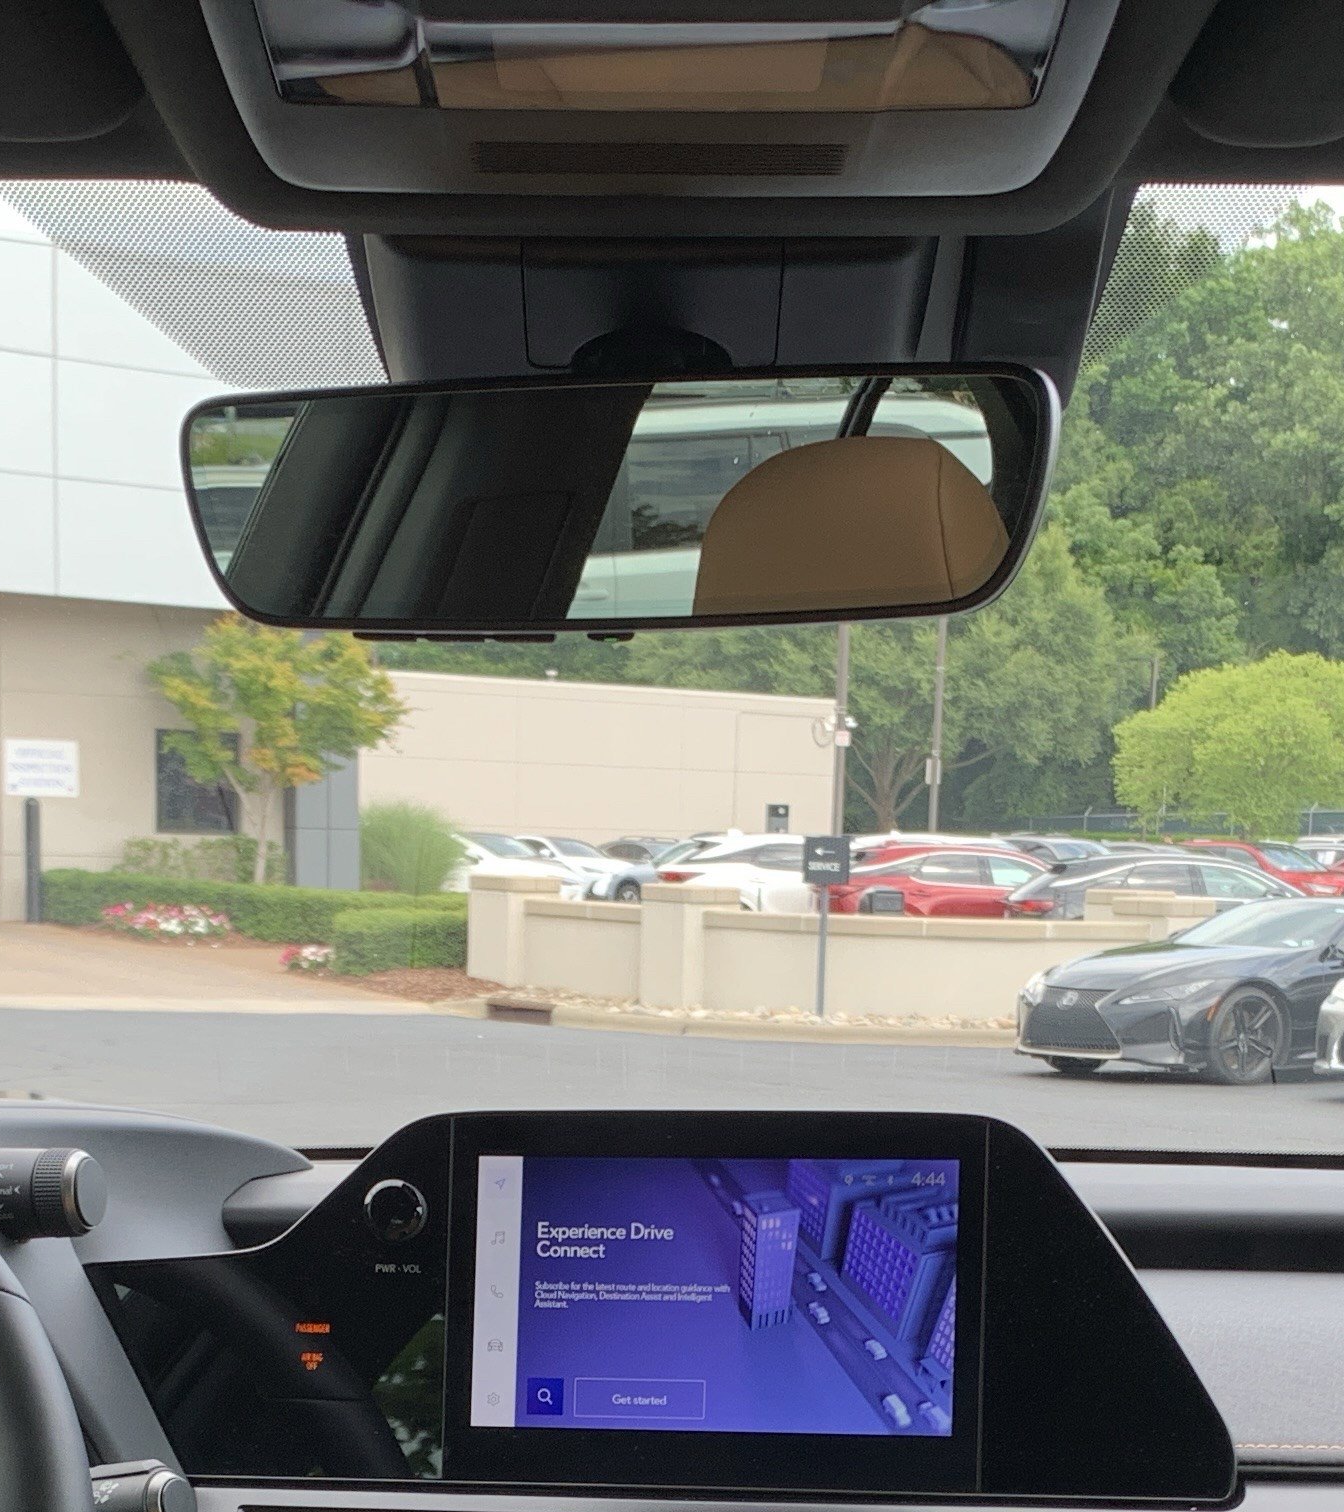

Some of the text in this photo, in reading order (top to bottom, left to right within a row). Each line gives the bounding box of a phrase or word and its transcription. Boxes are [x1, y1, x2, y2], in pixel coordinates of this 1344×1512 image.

[910, 1172, 946, 1187] 4:44
[537, 1221, 674, 1243] Experience Drive
[536, 1240, 606, 1259] Connect
[375, 1263, 422, 1274] PWR VOL
[534, 1281, 569, 1291] Subscribe
[571, 1281, 581, 1291] for
[582, 1281, 594, 1291] the
[595, 1282, 616, 1292] latest
[616, 1283, 636, 1292] route
[534, 1291, 557, 1300] Cloud
[612, 1393, 667, 1407] Get started
